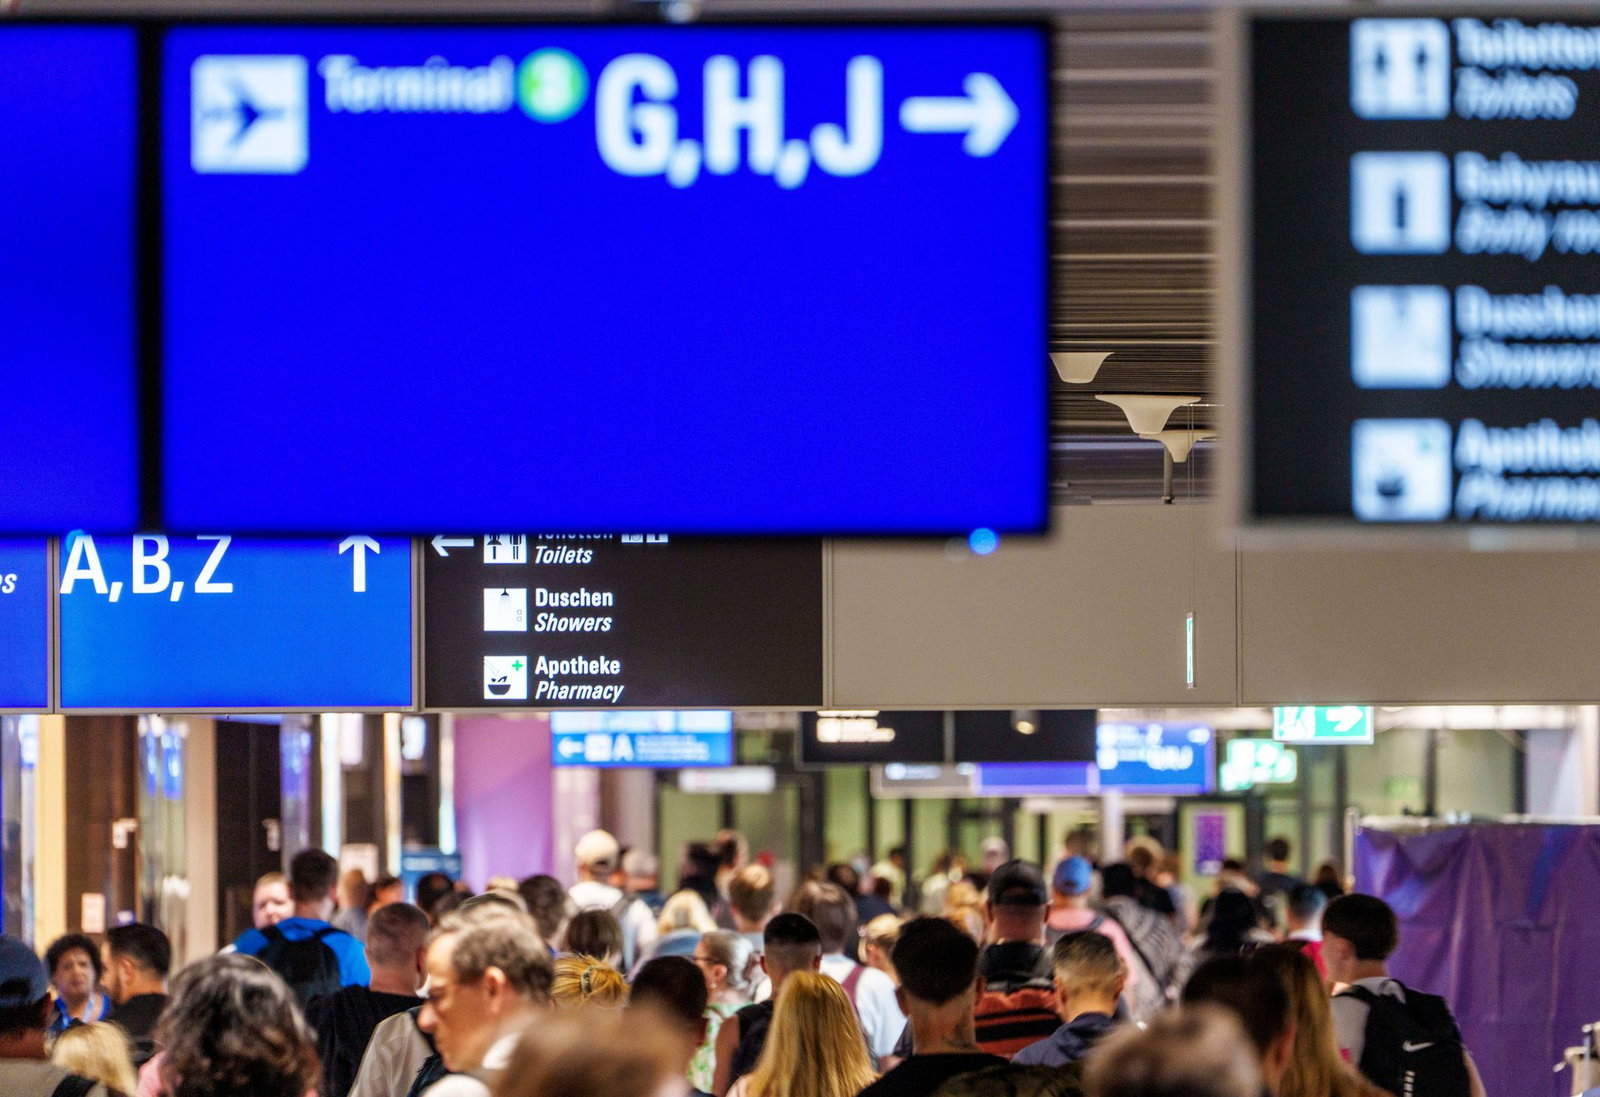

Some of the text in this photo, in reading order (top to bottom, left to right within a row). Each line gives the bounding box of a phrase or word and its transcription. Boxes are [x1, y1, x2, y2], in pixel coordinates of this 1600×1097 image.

[317, 55, 513, 113] Terminal
[595, 54, 883, 188] G,H,J
[535, 546, 593, 564] Toilets
[535, 588, 613, 607] Duschen
[535, 613, 612, 632] Showers
[535, 656, 621, 678] Apotheke
[535, 681, 624, 703] Pharmacy
